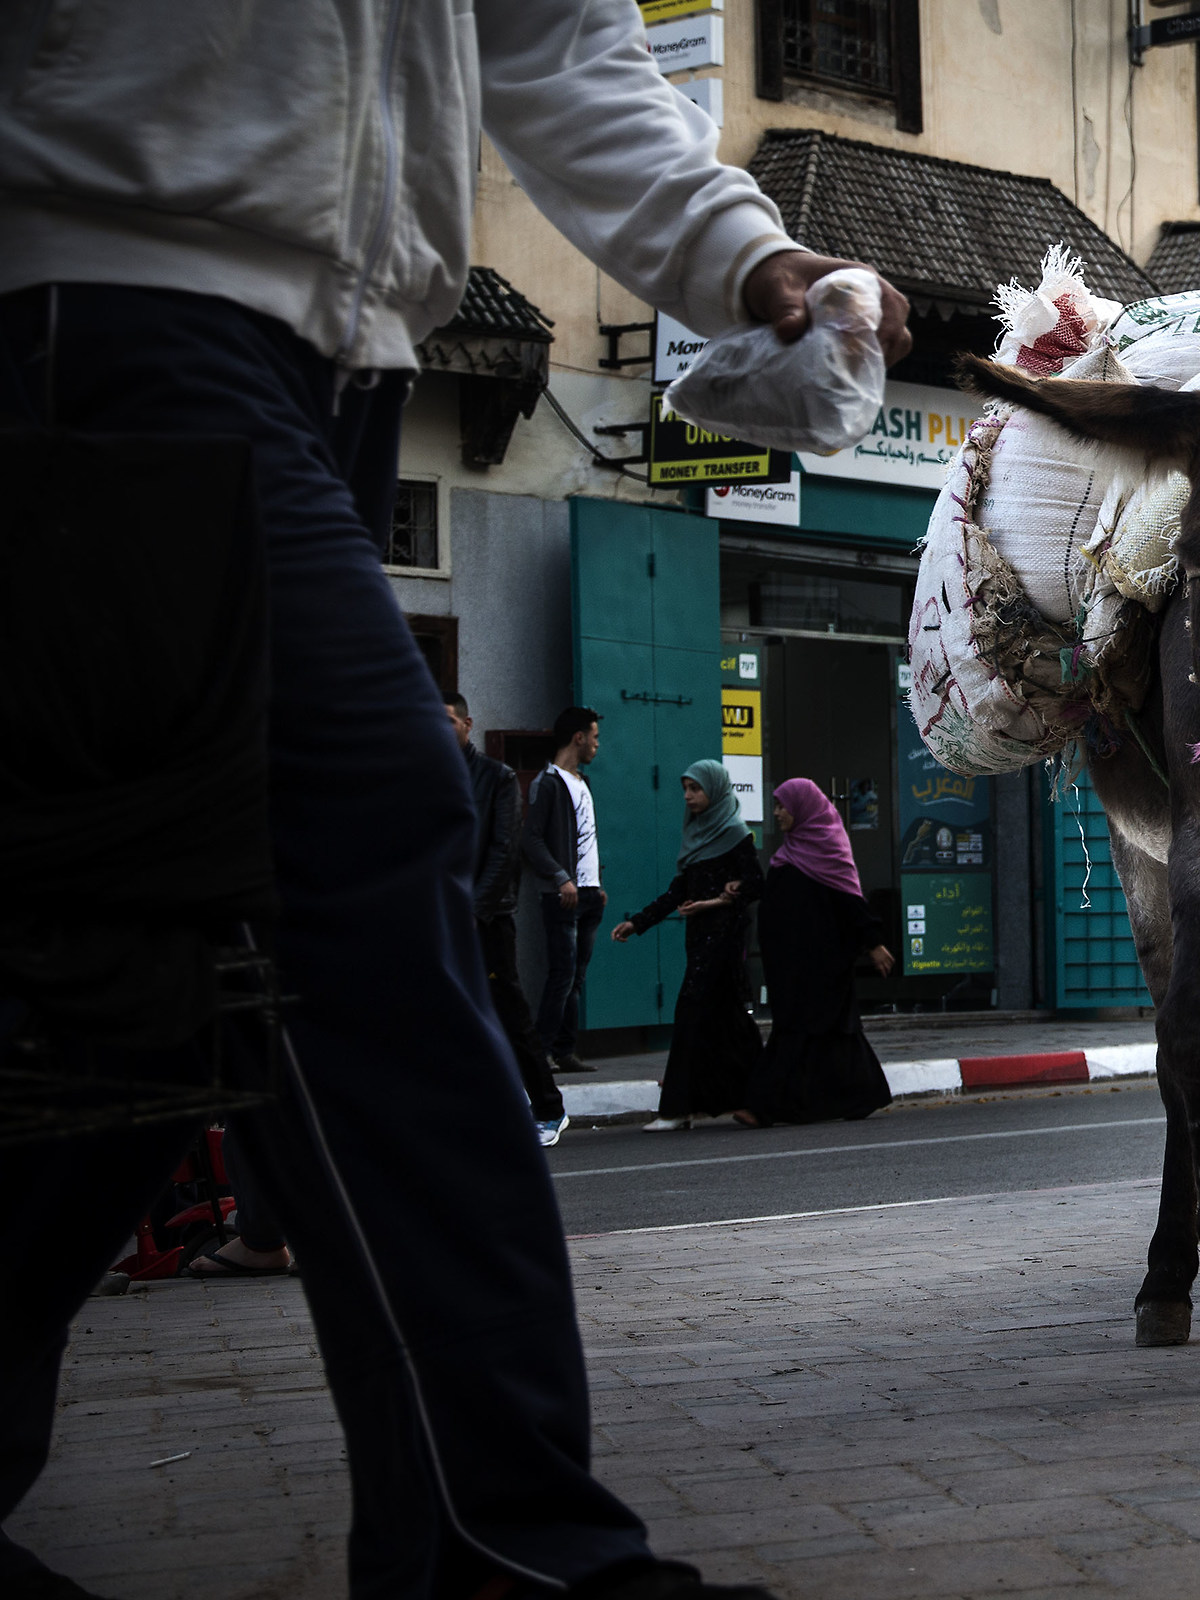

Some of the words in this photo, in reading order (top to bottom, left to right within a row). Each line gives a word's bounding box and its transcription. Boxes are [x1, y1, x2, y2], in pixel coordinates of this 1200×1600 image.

[867, 406, 921, 442] ASH
[660, 465, 697, 479] MONEY
[704, 461, 760, 476] TRANSFER
[731, 484, 796, 502] MoneyGram
